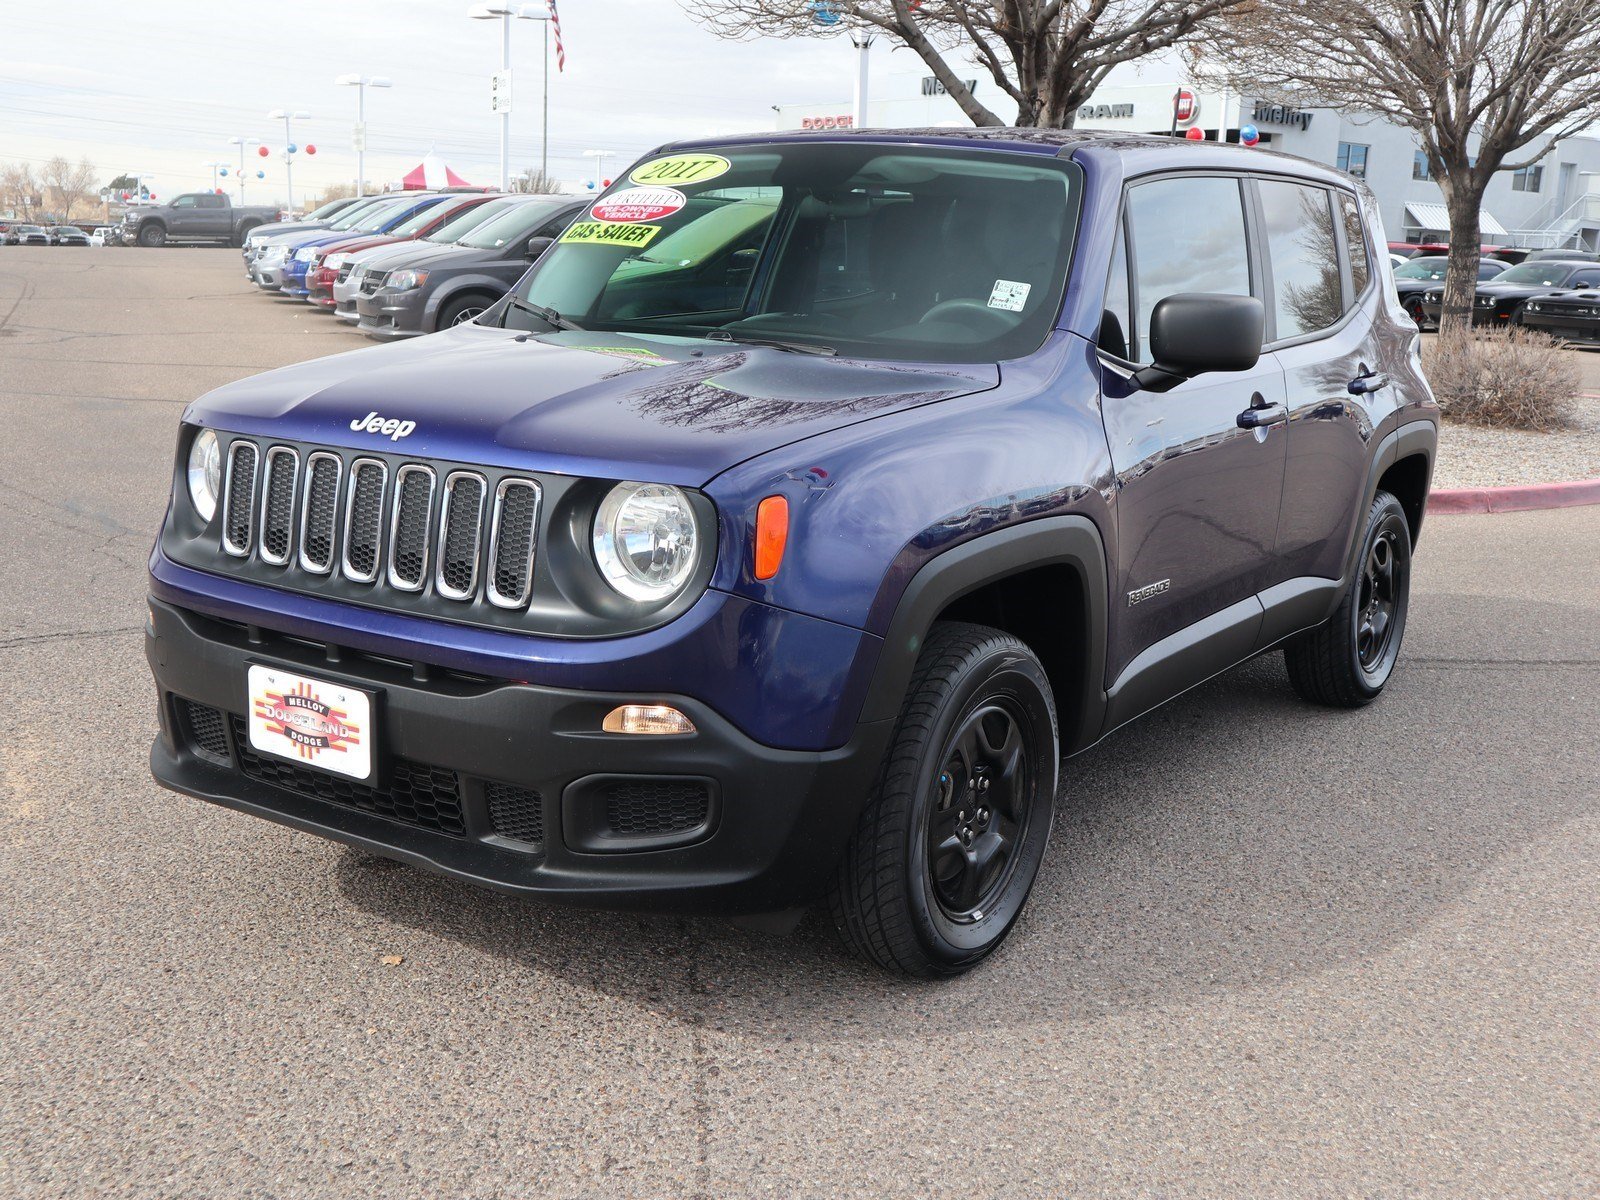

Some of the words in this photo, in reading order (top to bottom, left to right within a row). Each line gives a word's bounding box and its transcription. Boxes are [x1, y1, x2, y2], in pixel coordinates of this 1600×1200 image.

[922, 77, 977, 97] Mey
[1078, 103, 1134, 119] RAM
[639, 160, 718, 180] 2017
[598, 205, 664, 213] PRE-OWNED
[350, 411, 417, 441] Jeep
[1127, 578, 1171, 607] RENEGADE
[288, 697, 325, 713] MELLOY
[264, 704, 350, 738] DODGELAND
[291, 731, 323, 747] DODGE
